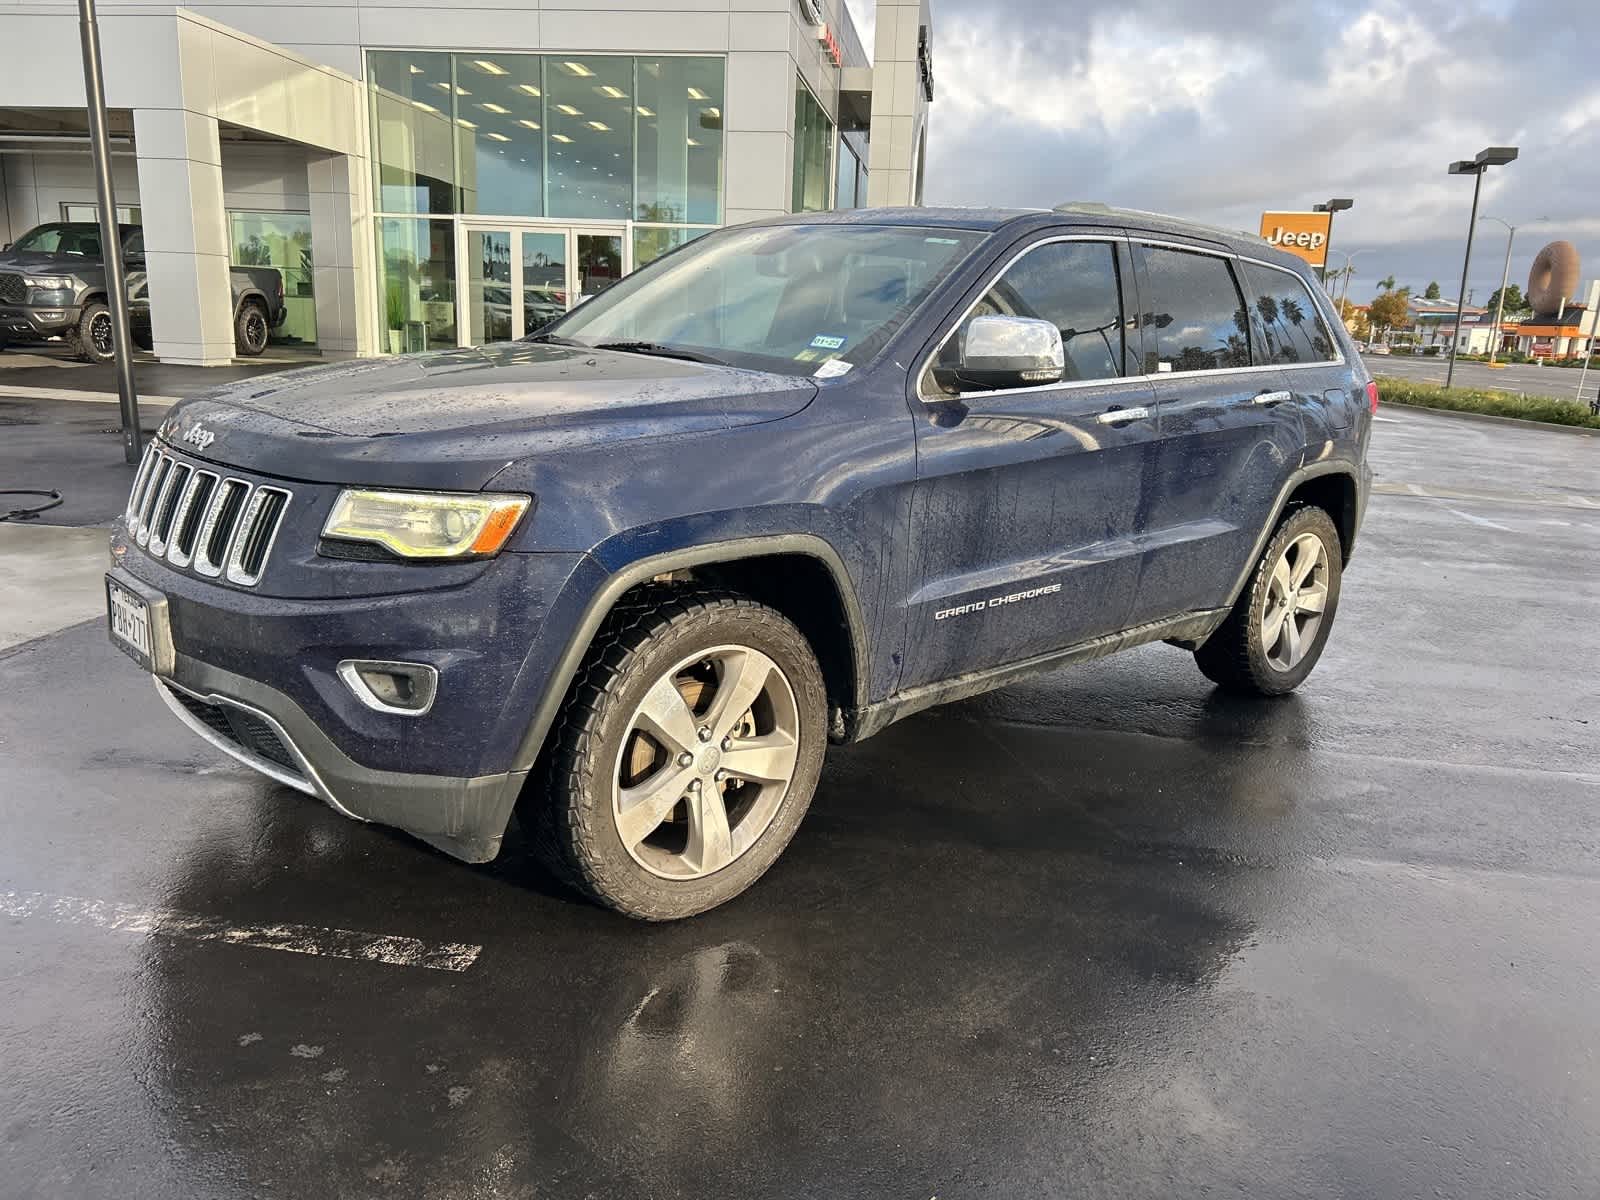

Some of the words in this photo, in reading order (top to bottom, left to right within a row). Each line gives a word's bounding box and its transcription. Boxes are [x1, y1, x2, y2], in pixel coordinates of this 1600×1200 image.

[1266, 226, 1325, 250] Jeep
[183, 422, 215, 451] Jeep
[935, 601, 986, 620] GRAND
[988, 583, 1062, 608] CHEROKEE
